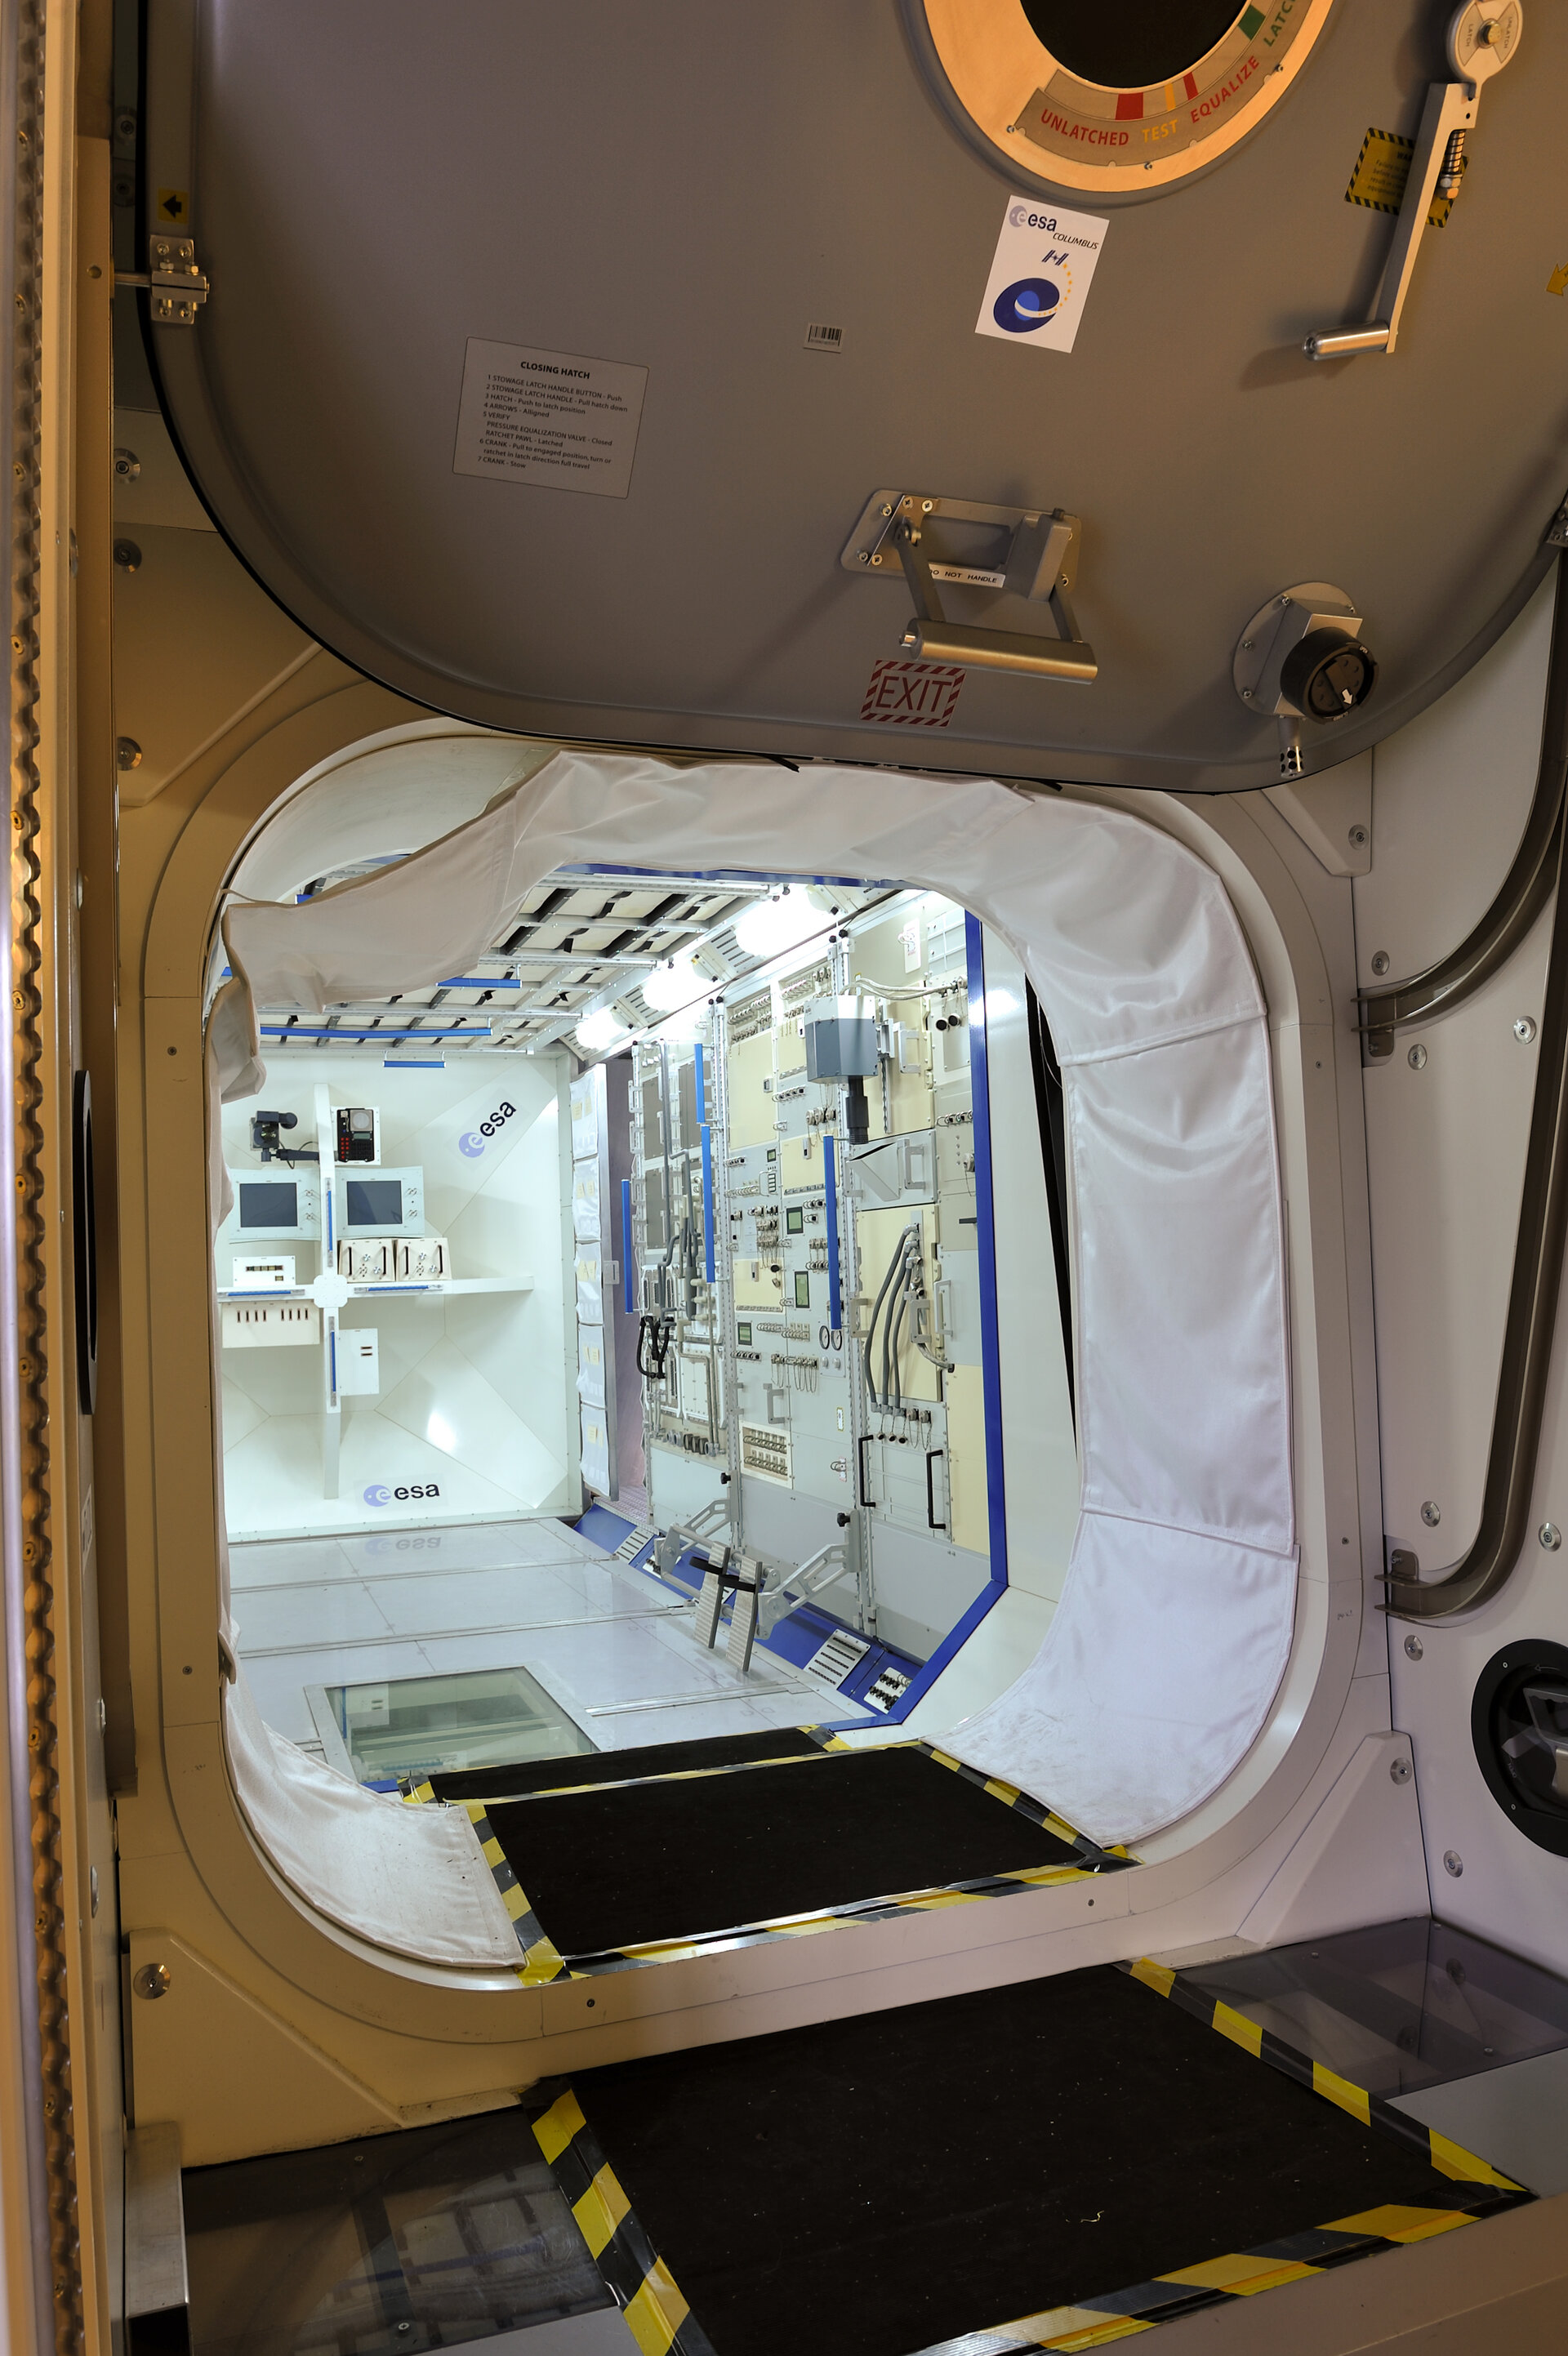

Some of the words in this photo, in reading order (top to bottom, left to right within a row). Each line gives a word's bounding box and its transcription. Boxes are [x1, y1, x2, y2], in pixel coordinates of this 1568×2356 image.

[1263, 0, 1296, 47] LATC
[1466, 24, 1474, 47] LATCH
[1041, 109, 1129, 147] UNLATCHED
[1142, 119, 1178, 144] TEST
[1190, 55, 1261, 125] EQUALIZE
[1027, 213, 1058, 233] esa
[1052, 232, 1100, 251] COLUMBUS
[519, 360, 559, 375] CLOSING
[560, 367, 590, 380] HATCH
[492, 374, 525, 387] STOWAGE
[525, 380, 547, 391] LATCH
[547, 384, 575, 395] HANDLE
[575, 388, 603, 399] BUTTON
[606, 393, 622, 403] Push
[492, 384, 523, 396] STOWAGE
[524, 390, 546, 399] LATCH
[546, 393, 573, 404] HANDLE
[577, 398, 591, 407] Pull
[590, 400, 609, 410] hatch
[609, 403, 628, 412] down
[488, 402, 519, 413] ARROWS
[490, 393, 514, 403] HATCH
[517, 397, 534, 407] Push
[542, 401, 559, 411] latch
[559, 405, 586, 415] position
[488, 411, 510, 421] VERIFY
[485, 429, 515, 440] RATCHET
[514, 433, 533, 443] PAWL
[537, 437, 564, 448] Latched
[486, 420, 519, 432] PRESSURE
[519, 425, 568, 440] EQUALIZATION
[567, 433, 587, 443] VALVE
[590, 437, 613, 447] Closed
[483, 448, 507, 457] ratchet
[514, 452, 531, 461] latch
[531, 455, 560, 465] direction
[560, 459, 572, 467] full
[572, 461, 590, 470] travel
[484, 438, 508, 448] CRANK
[512, 442, 525, 452] Pull
[532, 447, 562, 457] engaged
[590, 455, 604, 463] turn
[482, 456, 506, 465] CRANK
[510, 460, 527, 469] Stow
[967, 574, 998, 583] HANDLE
[875, 675, 953, 713] EXIT
[479, 1099, 517, 1138] esa
[394, 1481, 440, 1501] esa
